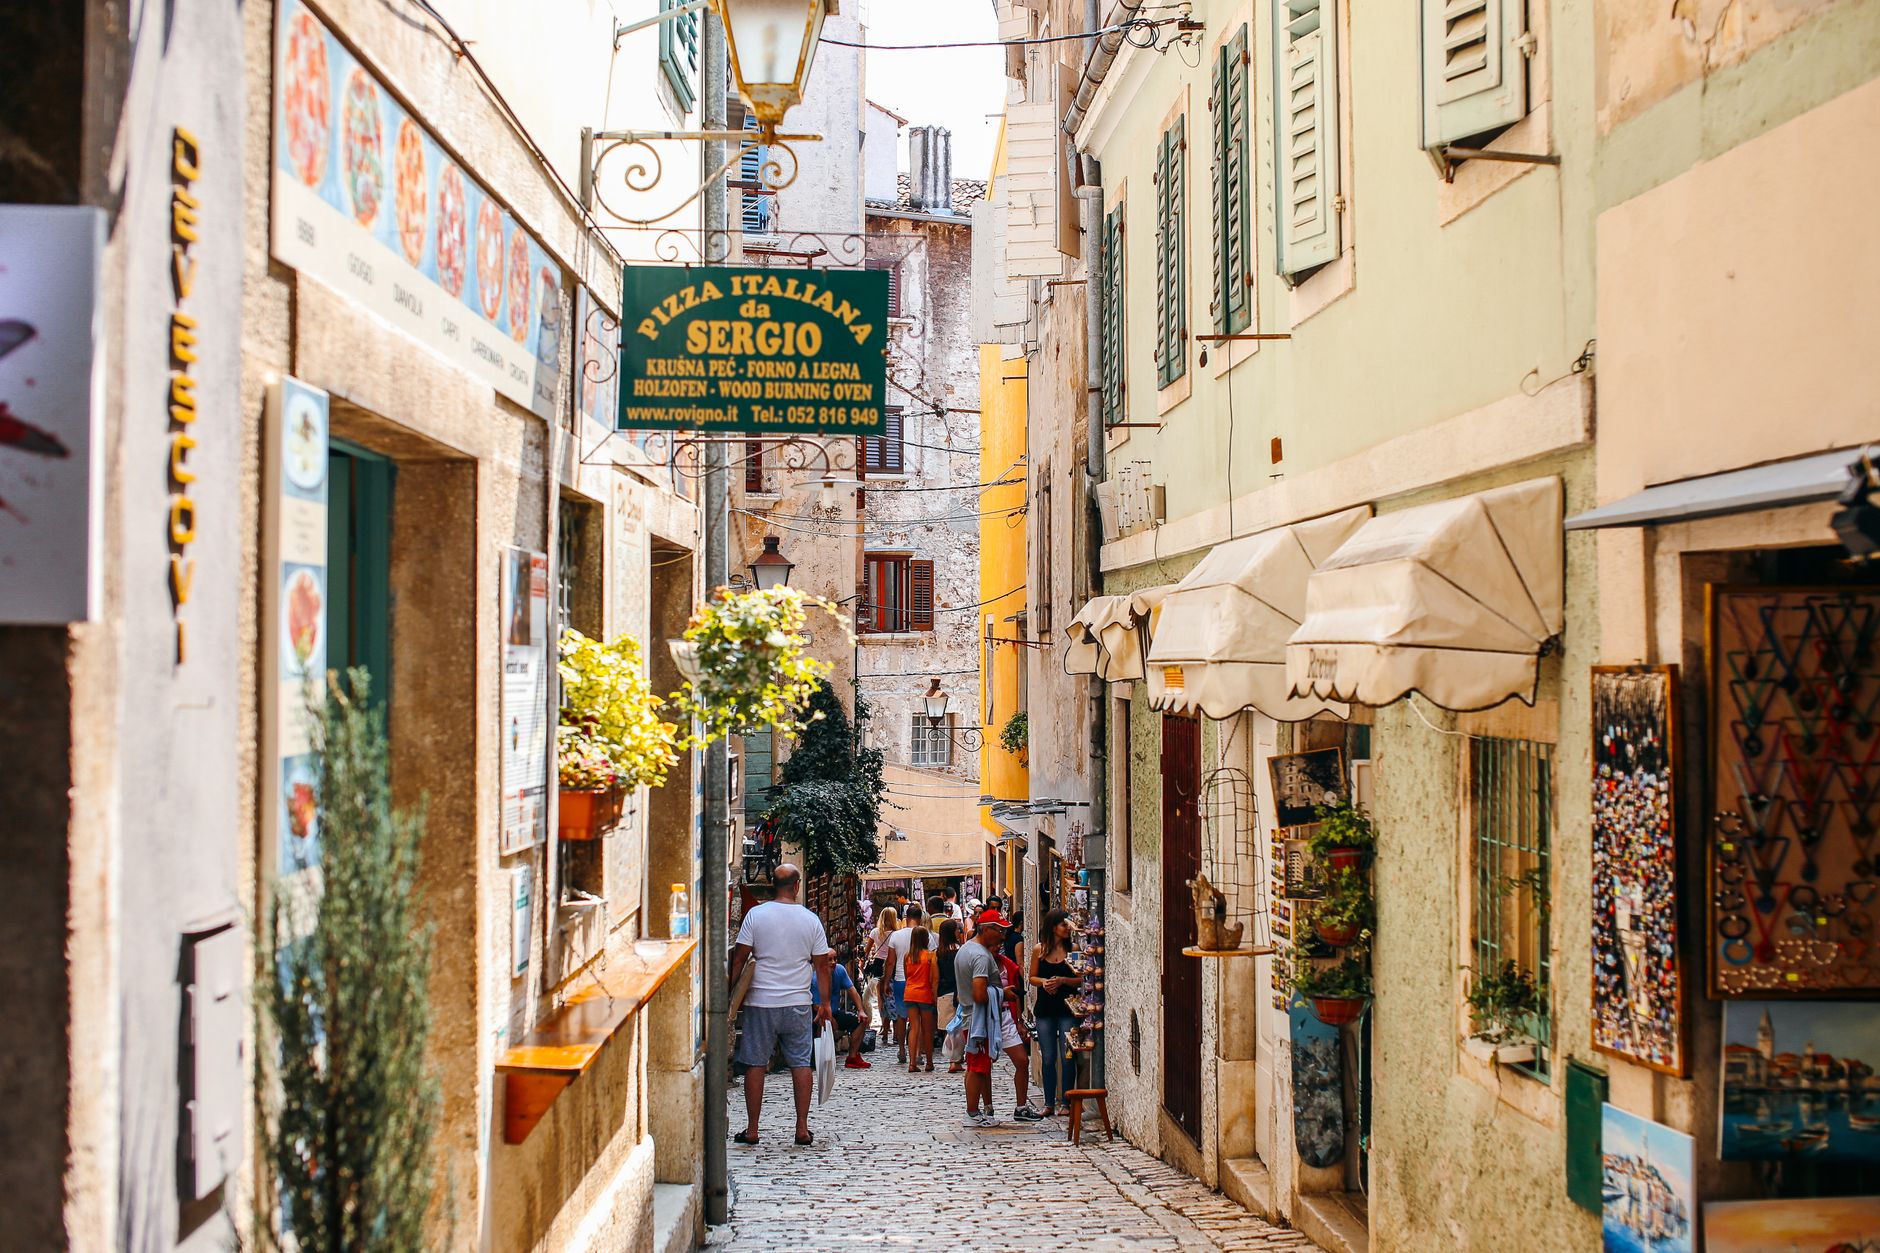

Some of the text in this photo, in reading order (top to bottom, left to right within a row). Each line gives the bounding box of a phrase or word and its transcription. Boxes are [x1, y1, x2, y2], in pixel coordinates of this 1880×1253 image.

[637, 274, 873, 345] PIZZA ITALIANA
[740, 299, 770, 318] da
[686, 319, 822, 357] SERGIO
[646, 356, 861, 380] KRUŠNA PEĆ FORNO A LEGNA
[633, 379, 873, 401] HOLZOFEN WOOD BURNING OVEN
[626, 404, 879, 426] www.rovigno.it Tel.: 052 816 949
